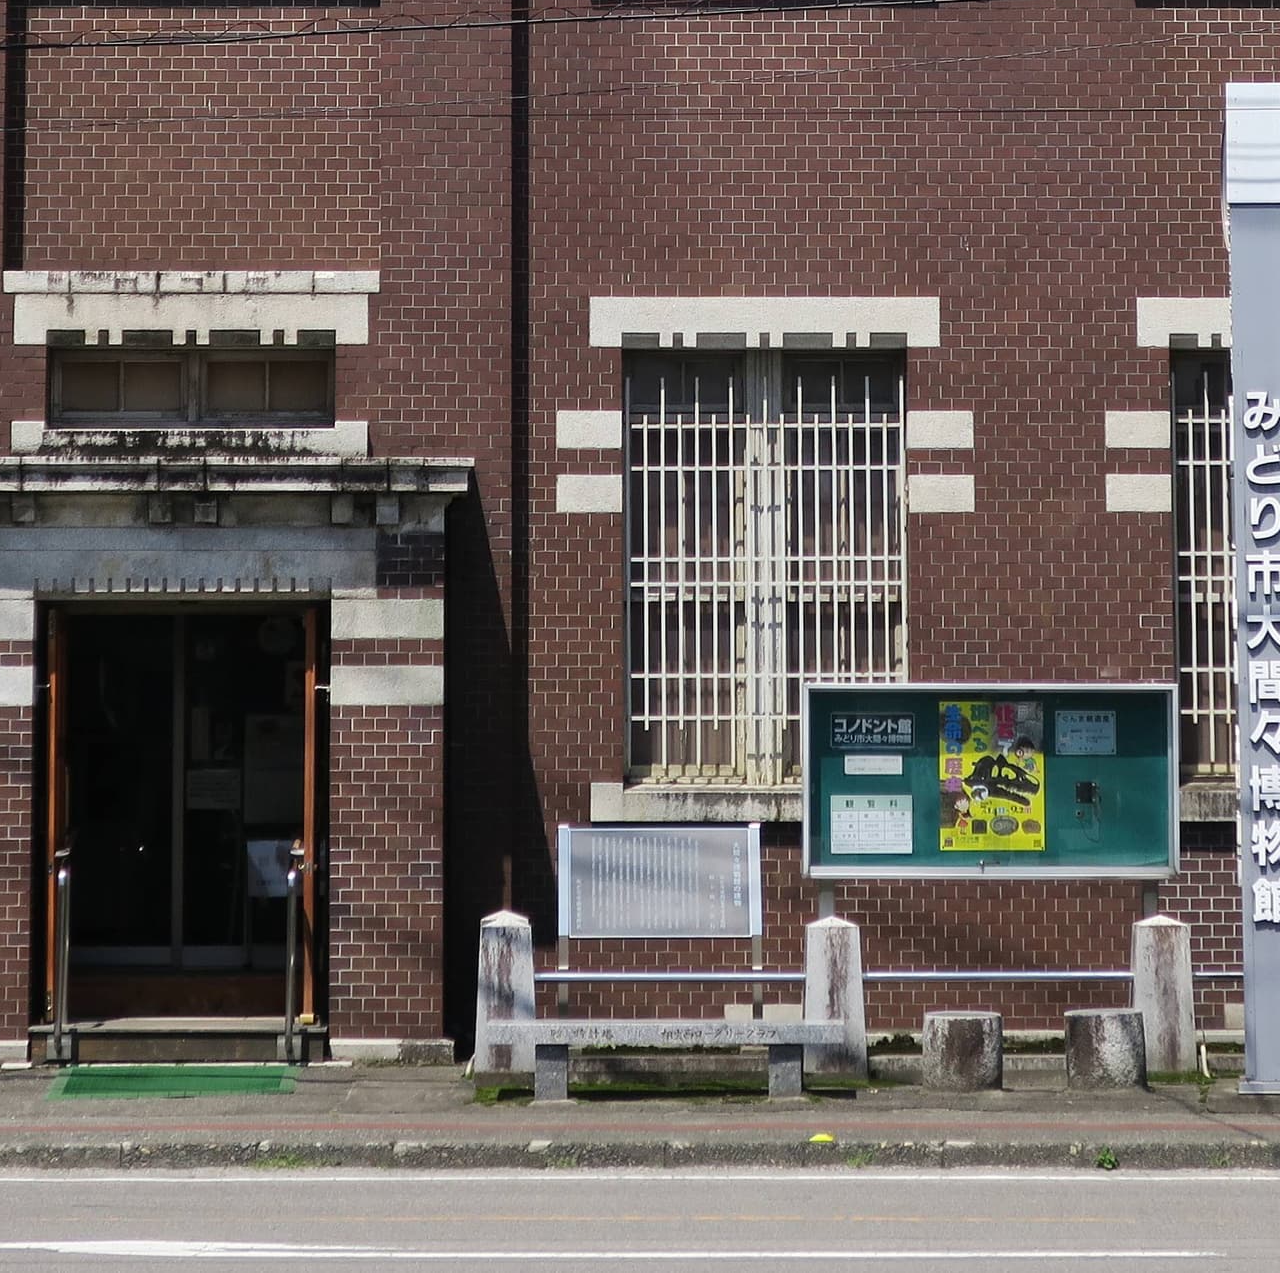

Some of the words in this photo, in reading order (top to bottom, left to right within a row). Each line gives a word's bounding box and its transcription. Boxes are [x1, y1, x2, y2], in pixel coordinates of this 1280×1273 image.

[834, 718, 912, 734] コノドント館
